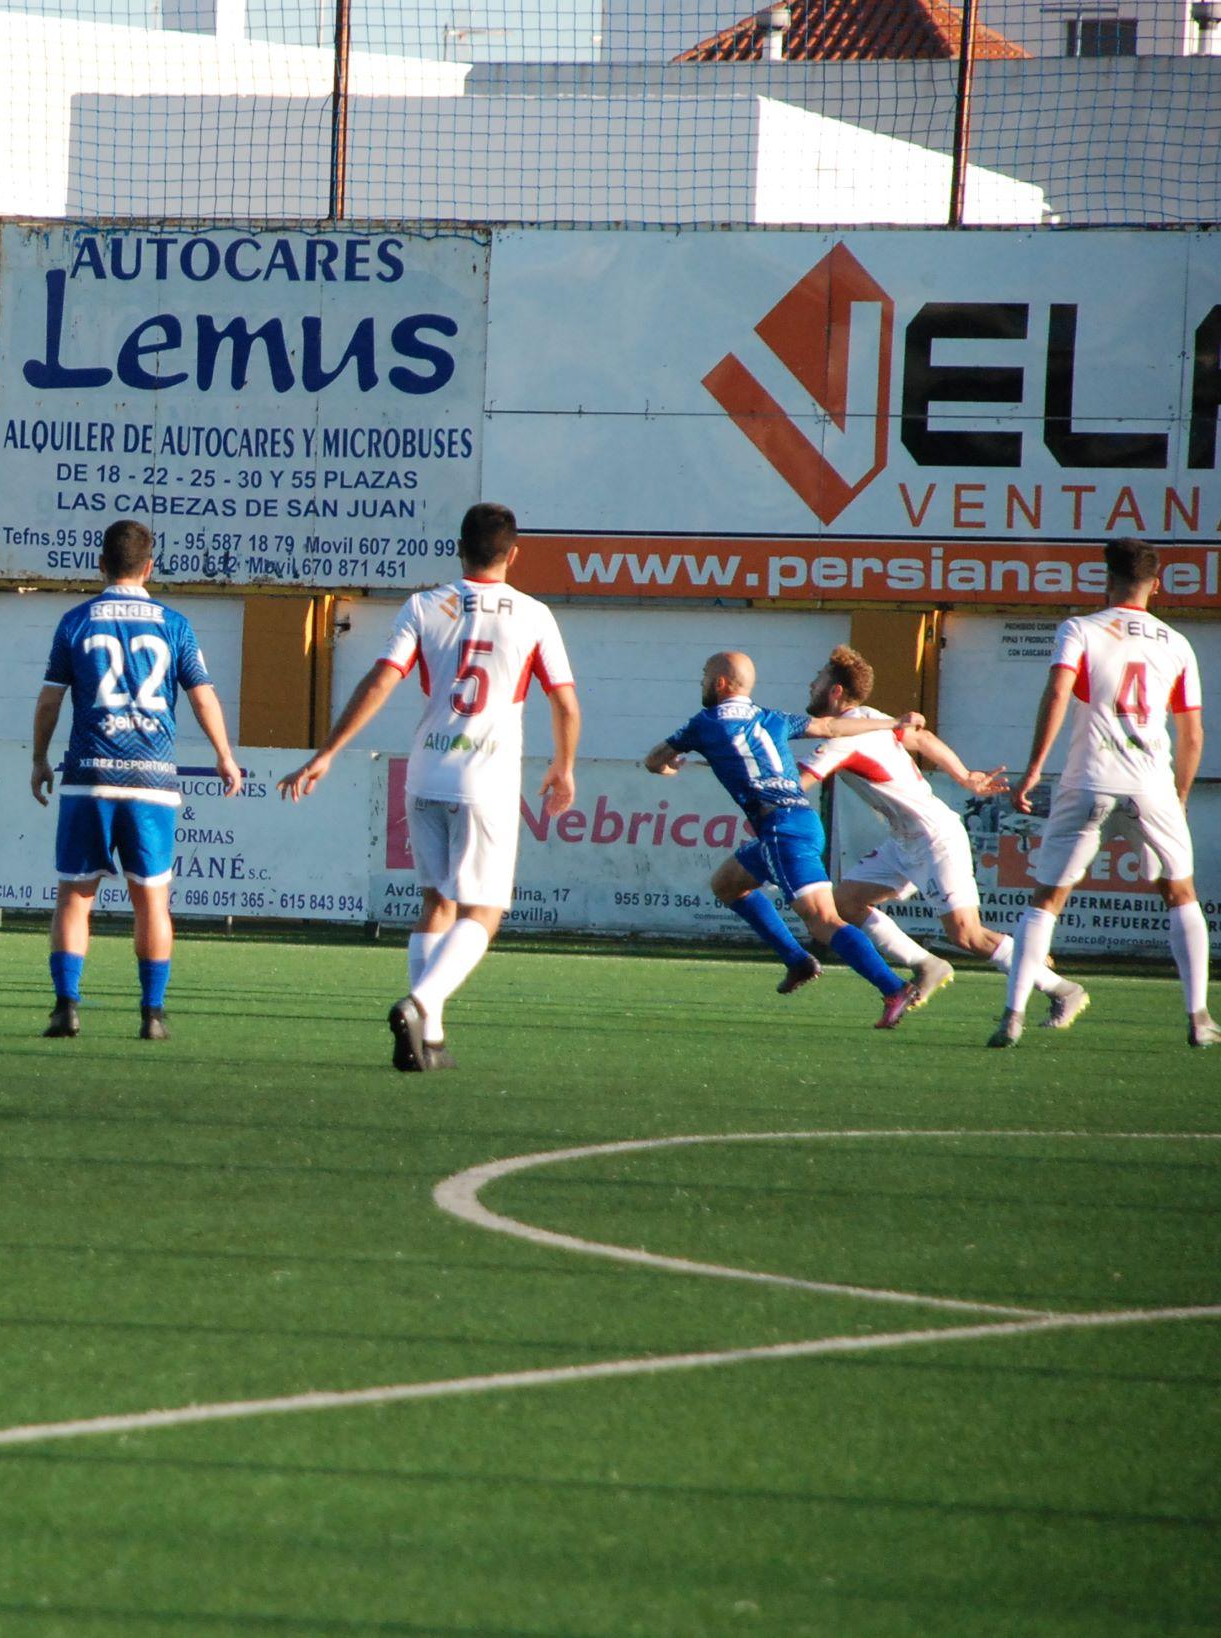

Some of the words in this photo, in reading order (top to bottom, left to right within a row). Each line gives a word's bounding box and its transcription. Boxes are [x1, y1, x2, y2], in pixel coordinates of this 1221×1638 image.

[69, 237, 405, 283] AUTOCARES
[23, 268, 459, 395] Lemus
[3, 419, 115, 453] ALQUILER
[123, 424, 153, 454] DE
[160, 425, 295, 459] AUTOCARES
[303, 428, 316, 458] Y
[323, 428, 473, 459] MICROBUSES
[56, 463, 88, 482] DE
[97, 465, 120, 483] 18
[143, 467, 168, 485] 22
[190, 469, 216, 487] 25
[237, 470, 262, 488] 30
[270, 470, 284, 488] Y
[291, 470, 316, 489] 55
[324, 470, 418, 489] PLAZAS
[57, 492, 106, 511] LAS
[114, 494, 237, 517] CABEZAS
[246, 499, 278, 517] DE
[287, 499, 338, 518] SAN
[347, 499, 416, 518] JUAN
[898, 482, 1221, 533] VENTAN
[83, 530, 103, 547] 98
[185, 532, 205, 550] 95
[212, 533, 241, 551] 587
[249, 534, 268, 551] 18
[274, 536, 295, 553] 79
[305, 536, 353, 554] Movil
[359, 537, 391, 555] 607
[397, 538, 428, 556] 200
[434, 539, 458, 557] 99
[48, 551, 100, 569] SEVIL
[169, 554, 200, 572] 680
[206, 555, 238, 573] 652
[249, 556, 298, 576] Movil
[302, 558, 332, 576] 670
[338, 559, 368, 577] 871
[375, 561, 406, 578] 451
[1025, 636, 1055, 644] PRODUCTO
[83, 634, 172, 711] 22
[449, 639, 494, 717] 5
[1114, 661, 1151, 728] 4
[732, 720, 784, 779] 11
[80, 757, 114, 769] XEREZ
[182, 806, 196, 821] &
[174, 828, 235, 844] ORMAS
[185, 890, 209, 905] 696
[213, 890, 235, 907] 051
[241, 892, 265, 908] 365
[280, 893, 305, 910] 615
[310, 894, 334, 911] 843
[339, 895, 364, 912] 934
[553, 888, 571, 902] 17
[614, 892, 640, 906] 955
[644, 893, 669, 907] 973
[674, 894, 700, 908] 364
[384, 902, 423, 917] 4174
[501, 907, 558, 924] Sevilla)
